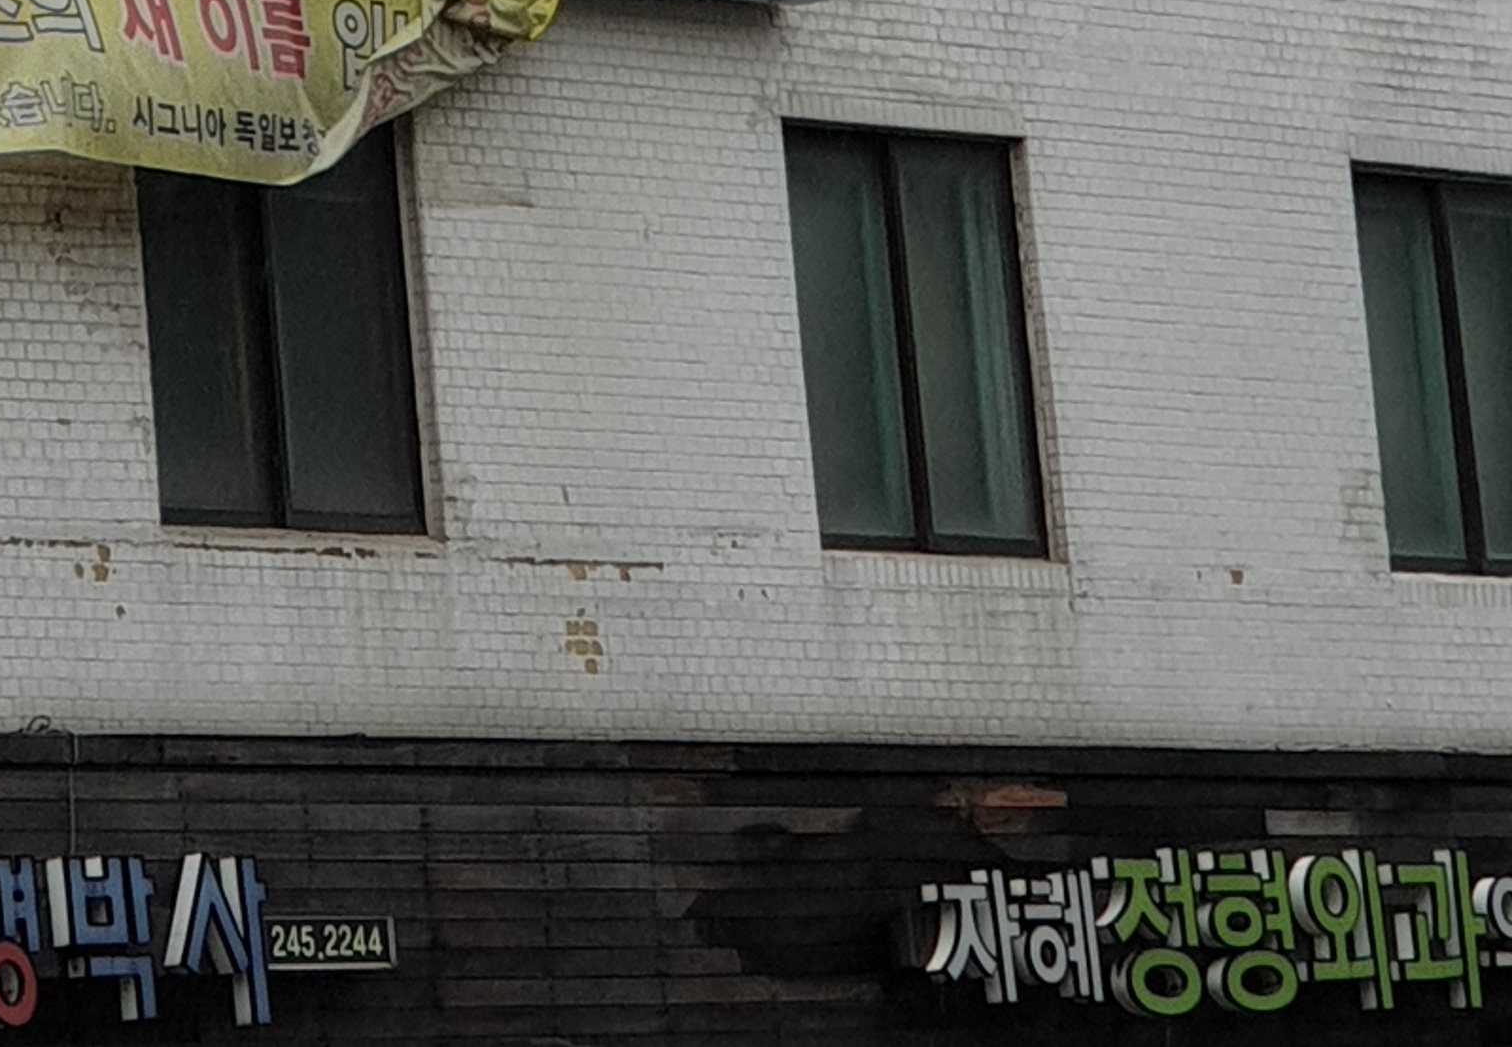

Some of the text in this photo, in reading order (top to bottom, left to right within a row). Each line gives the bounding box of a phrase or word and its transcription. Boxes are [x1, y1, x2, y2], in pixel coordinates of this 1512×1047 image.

[133, 96, 226, 146] 시그니아
[270, 922, 384, 963] 245.2244
[921, 868, 1106, 1004] 자혜
[1092, 847, 1488, 1015] 정형외과
